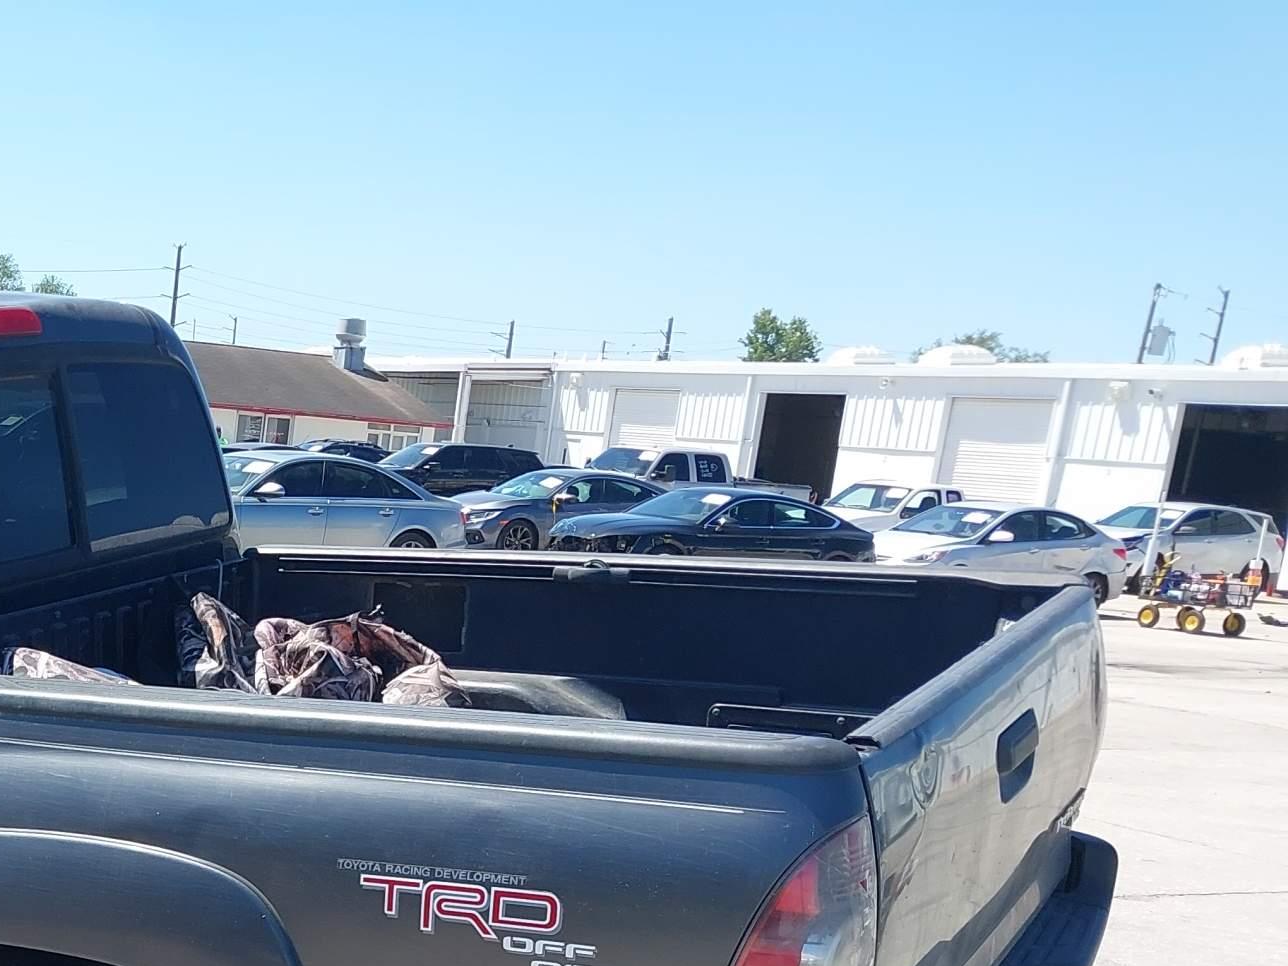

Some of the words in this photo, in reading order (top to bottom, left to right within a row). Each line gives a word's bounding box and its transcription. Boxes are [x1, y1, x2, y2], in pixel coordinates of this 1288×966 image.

[337, 858, 381, 873] TOYOTA
[385, 863, 431, 877] RACING
[434, 867, 528, 886] DEVELOPMENT
[360, 874, 562, 940] TRD
[502, 935, 597, 958] OFF
